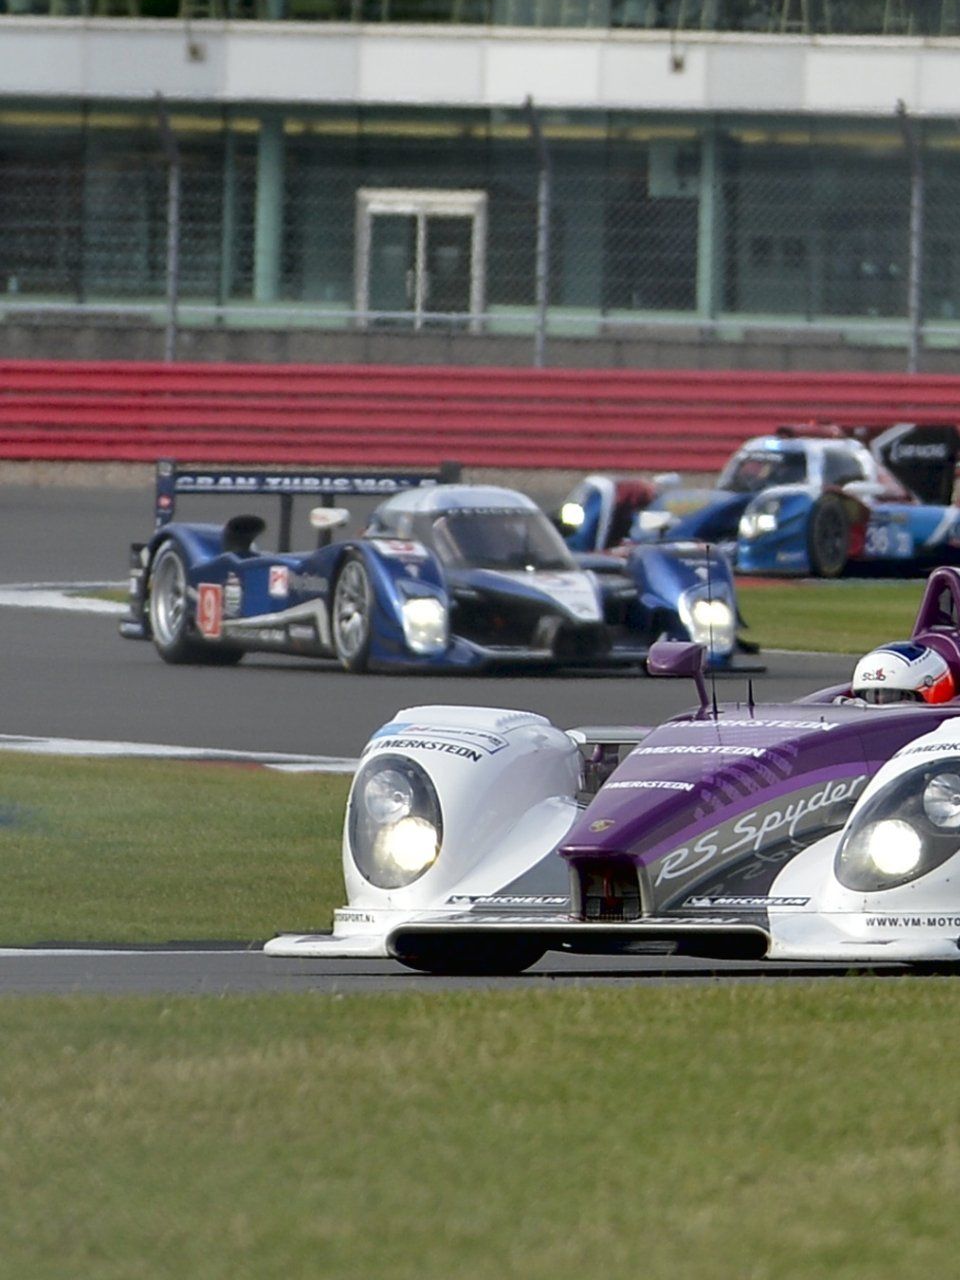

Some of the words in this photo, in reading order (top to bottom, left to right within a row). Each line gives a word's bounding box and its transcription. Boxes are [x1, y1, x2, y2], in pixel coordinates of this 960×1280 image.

[175, 476, 258, 490] GRAN
[265, 476, 397, 491] TURISMO
[203, 590, 217, 632] 9
[655, 831, 718, 887] RS
[721, 775, 866, 854] Spyder
[475, 895, 570, 905] MICHELIN
[715, 897, 808, 906] MICHELIN
